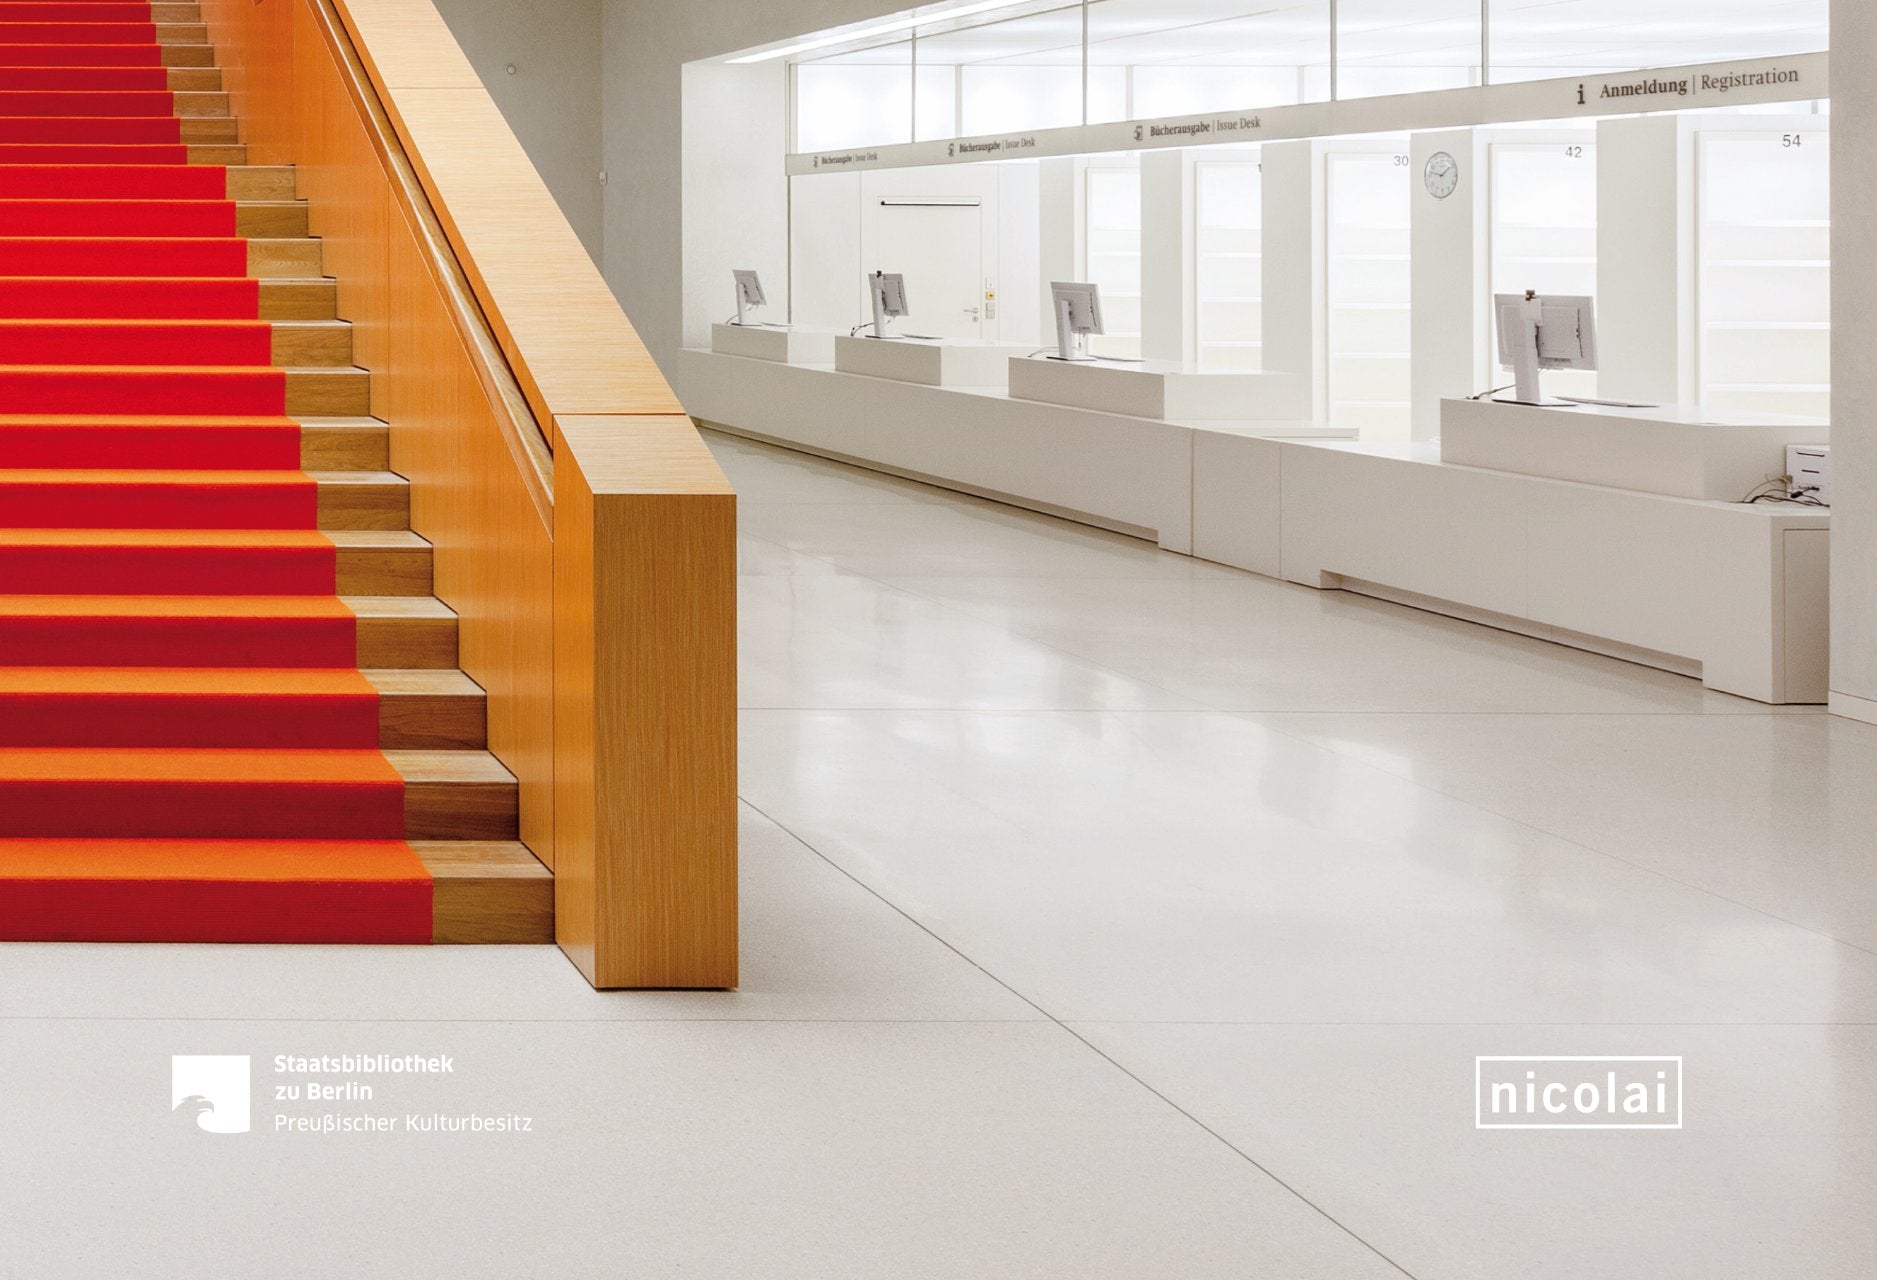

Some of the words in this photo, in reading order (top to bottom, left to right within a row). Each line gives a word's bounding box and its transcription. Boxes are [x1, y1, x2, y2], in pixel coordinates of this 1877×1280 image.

[1600, 77, 1688, 100] Anmeldung
[1700, 66, 1800, 94] Registration
[1149, 120, 1211, 138] Bücherausgabe
[1216, 119, 1238, 132] Issue
[1239, 116, 1261, 130] Desk
[1020, 136, 1035, 148] Desk
[1782, 133, 1802, 148] 54
[1565, 145, 1583, 159] 42
[1393, 155, 1409, 166] 30
